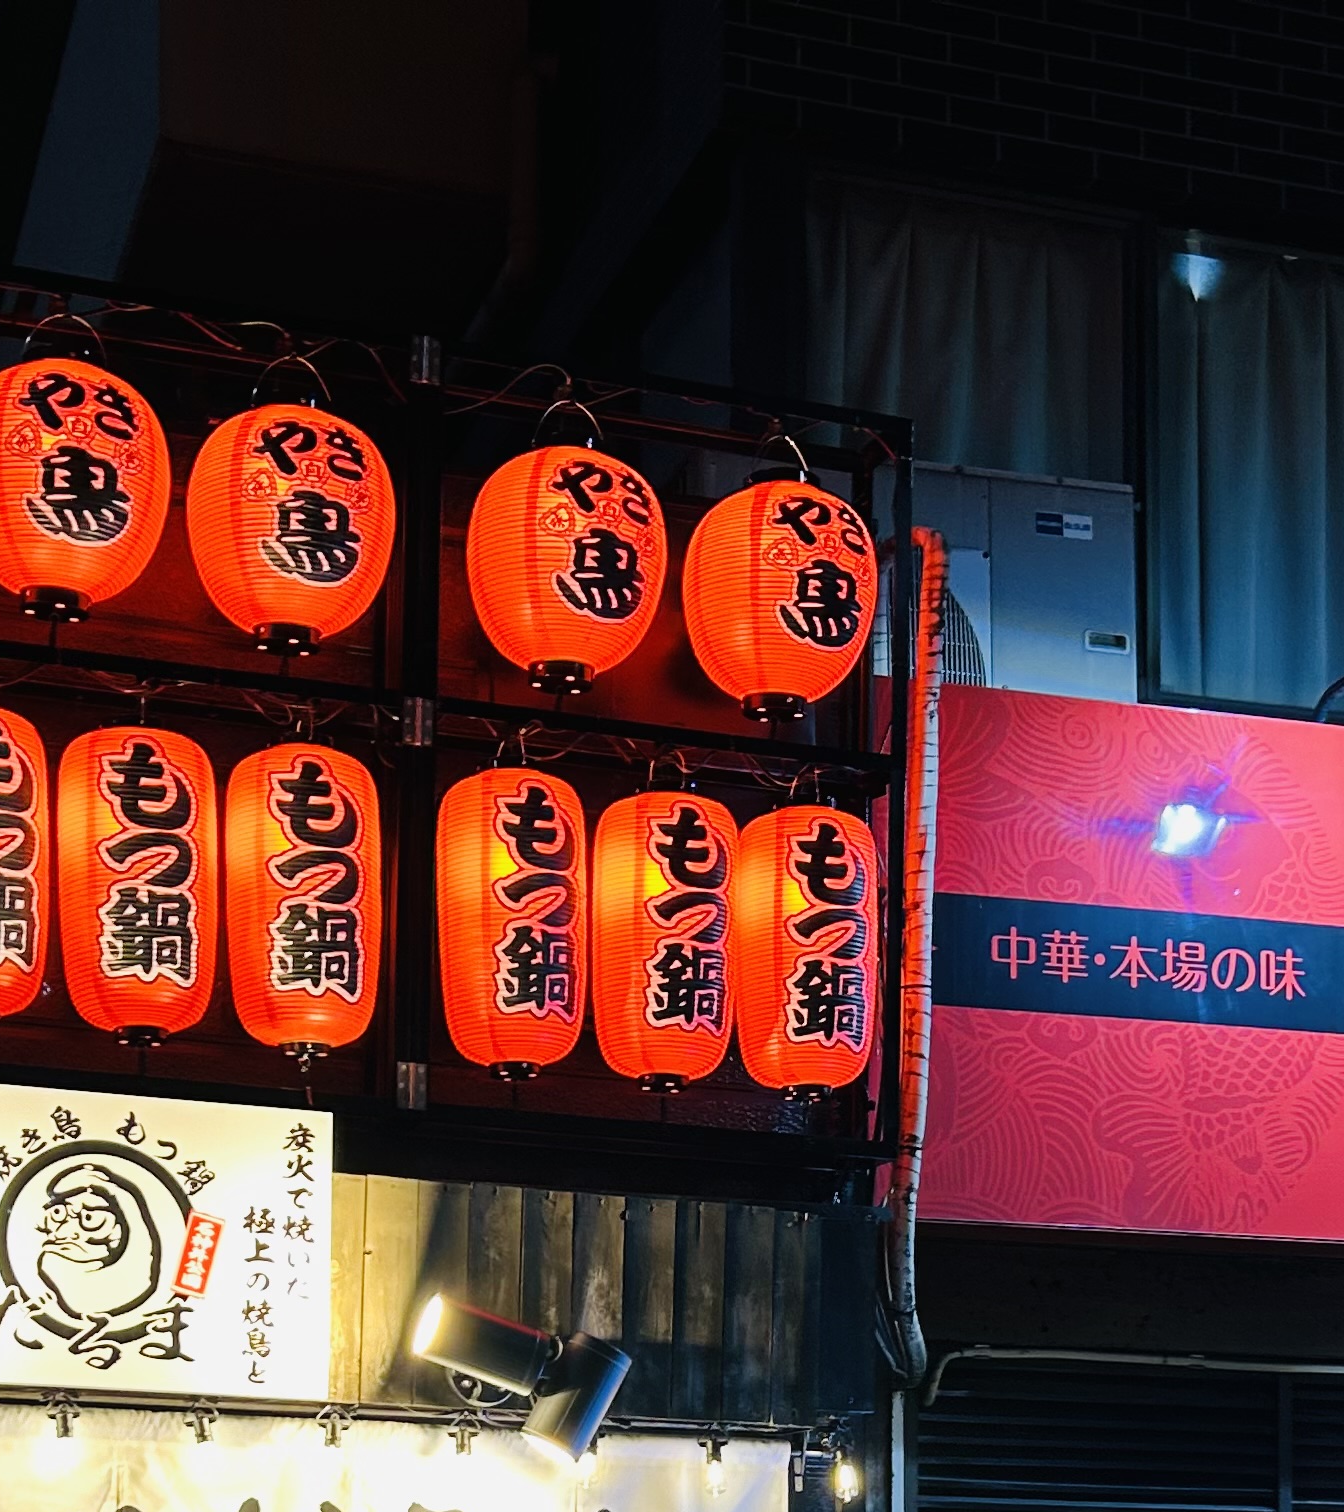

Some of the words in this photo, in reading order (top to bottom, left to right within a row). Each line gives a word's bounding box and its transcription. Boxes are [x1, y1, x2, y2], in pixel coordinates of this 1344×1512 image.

[100, 744, 195, 986] もつ鍋
[271, 761, 361, 1001] もつ鍋
[497, 787, 578, 1020] もつ鍋
[648, 807, 726, 1036] もつ鍋
[787, 823, 865, 1050] もつ鍋
[987, 929, 1308, 1002] 中華・本場の味
[241, 1205, 277, 1385] 極上の焼鳥と
[282, 1122, 317, 1301] 炭火で焼いた
